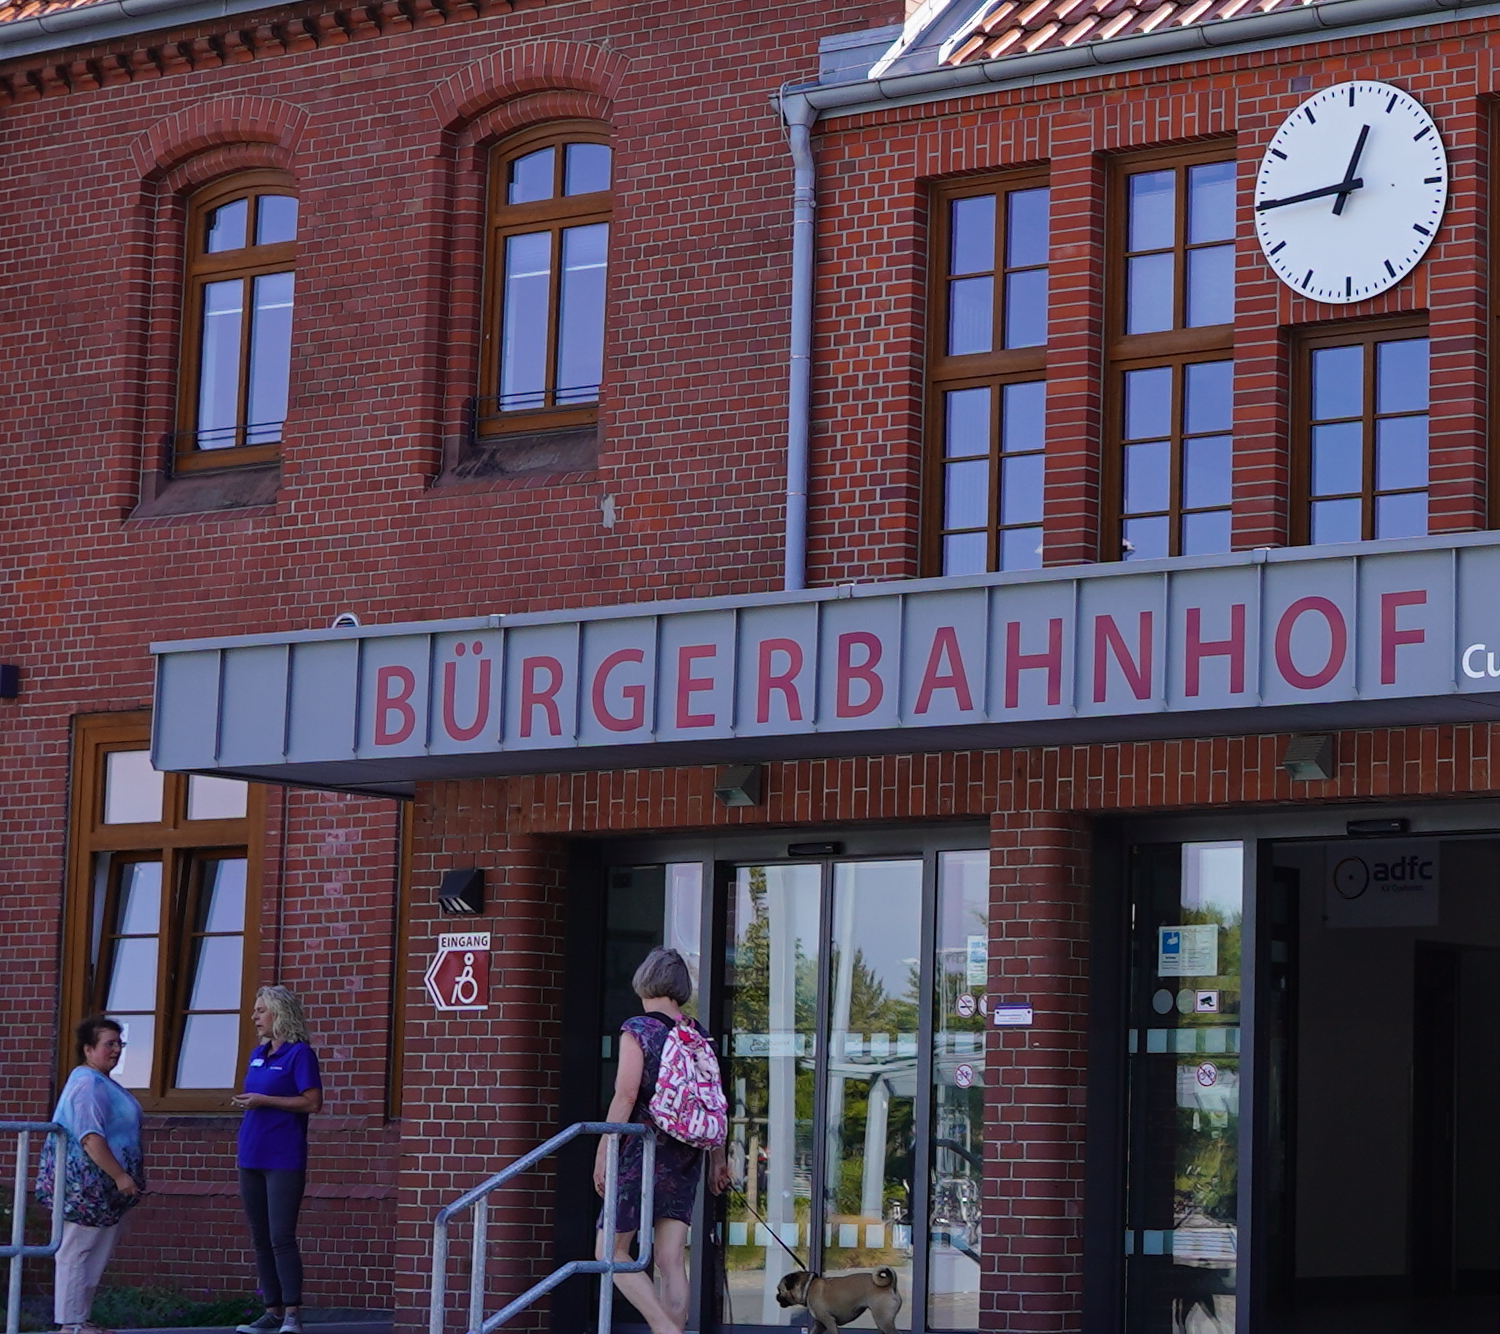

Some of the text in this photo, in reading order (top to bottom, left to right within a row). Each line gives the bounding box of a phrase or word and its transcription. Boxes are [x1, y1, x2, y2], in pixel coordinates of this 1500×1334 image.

[374, 589, 1428, 747] BÜRGERBAHNHOF
[1373, 855, 1433, 882] adfc
[441, 935, 489, 948] EINGANG
